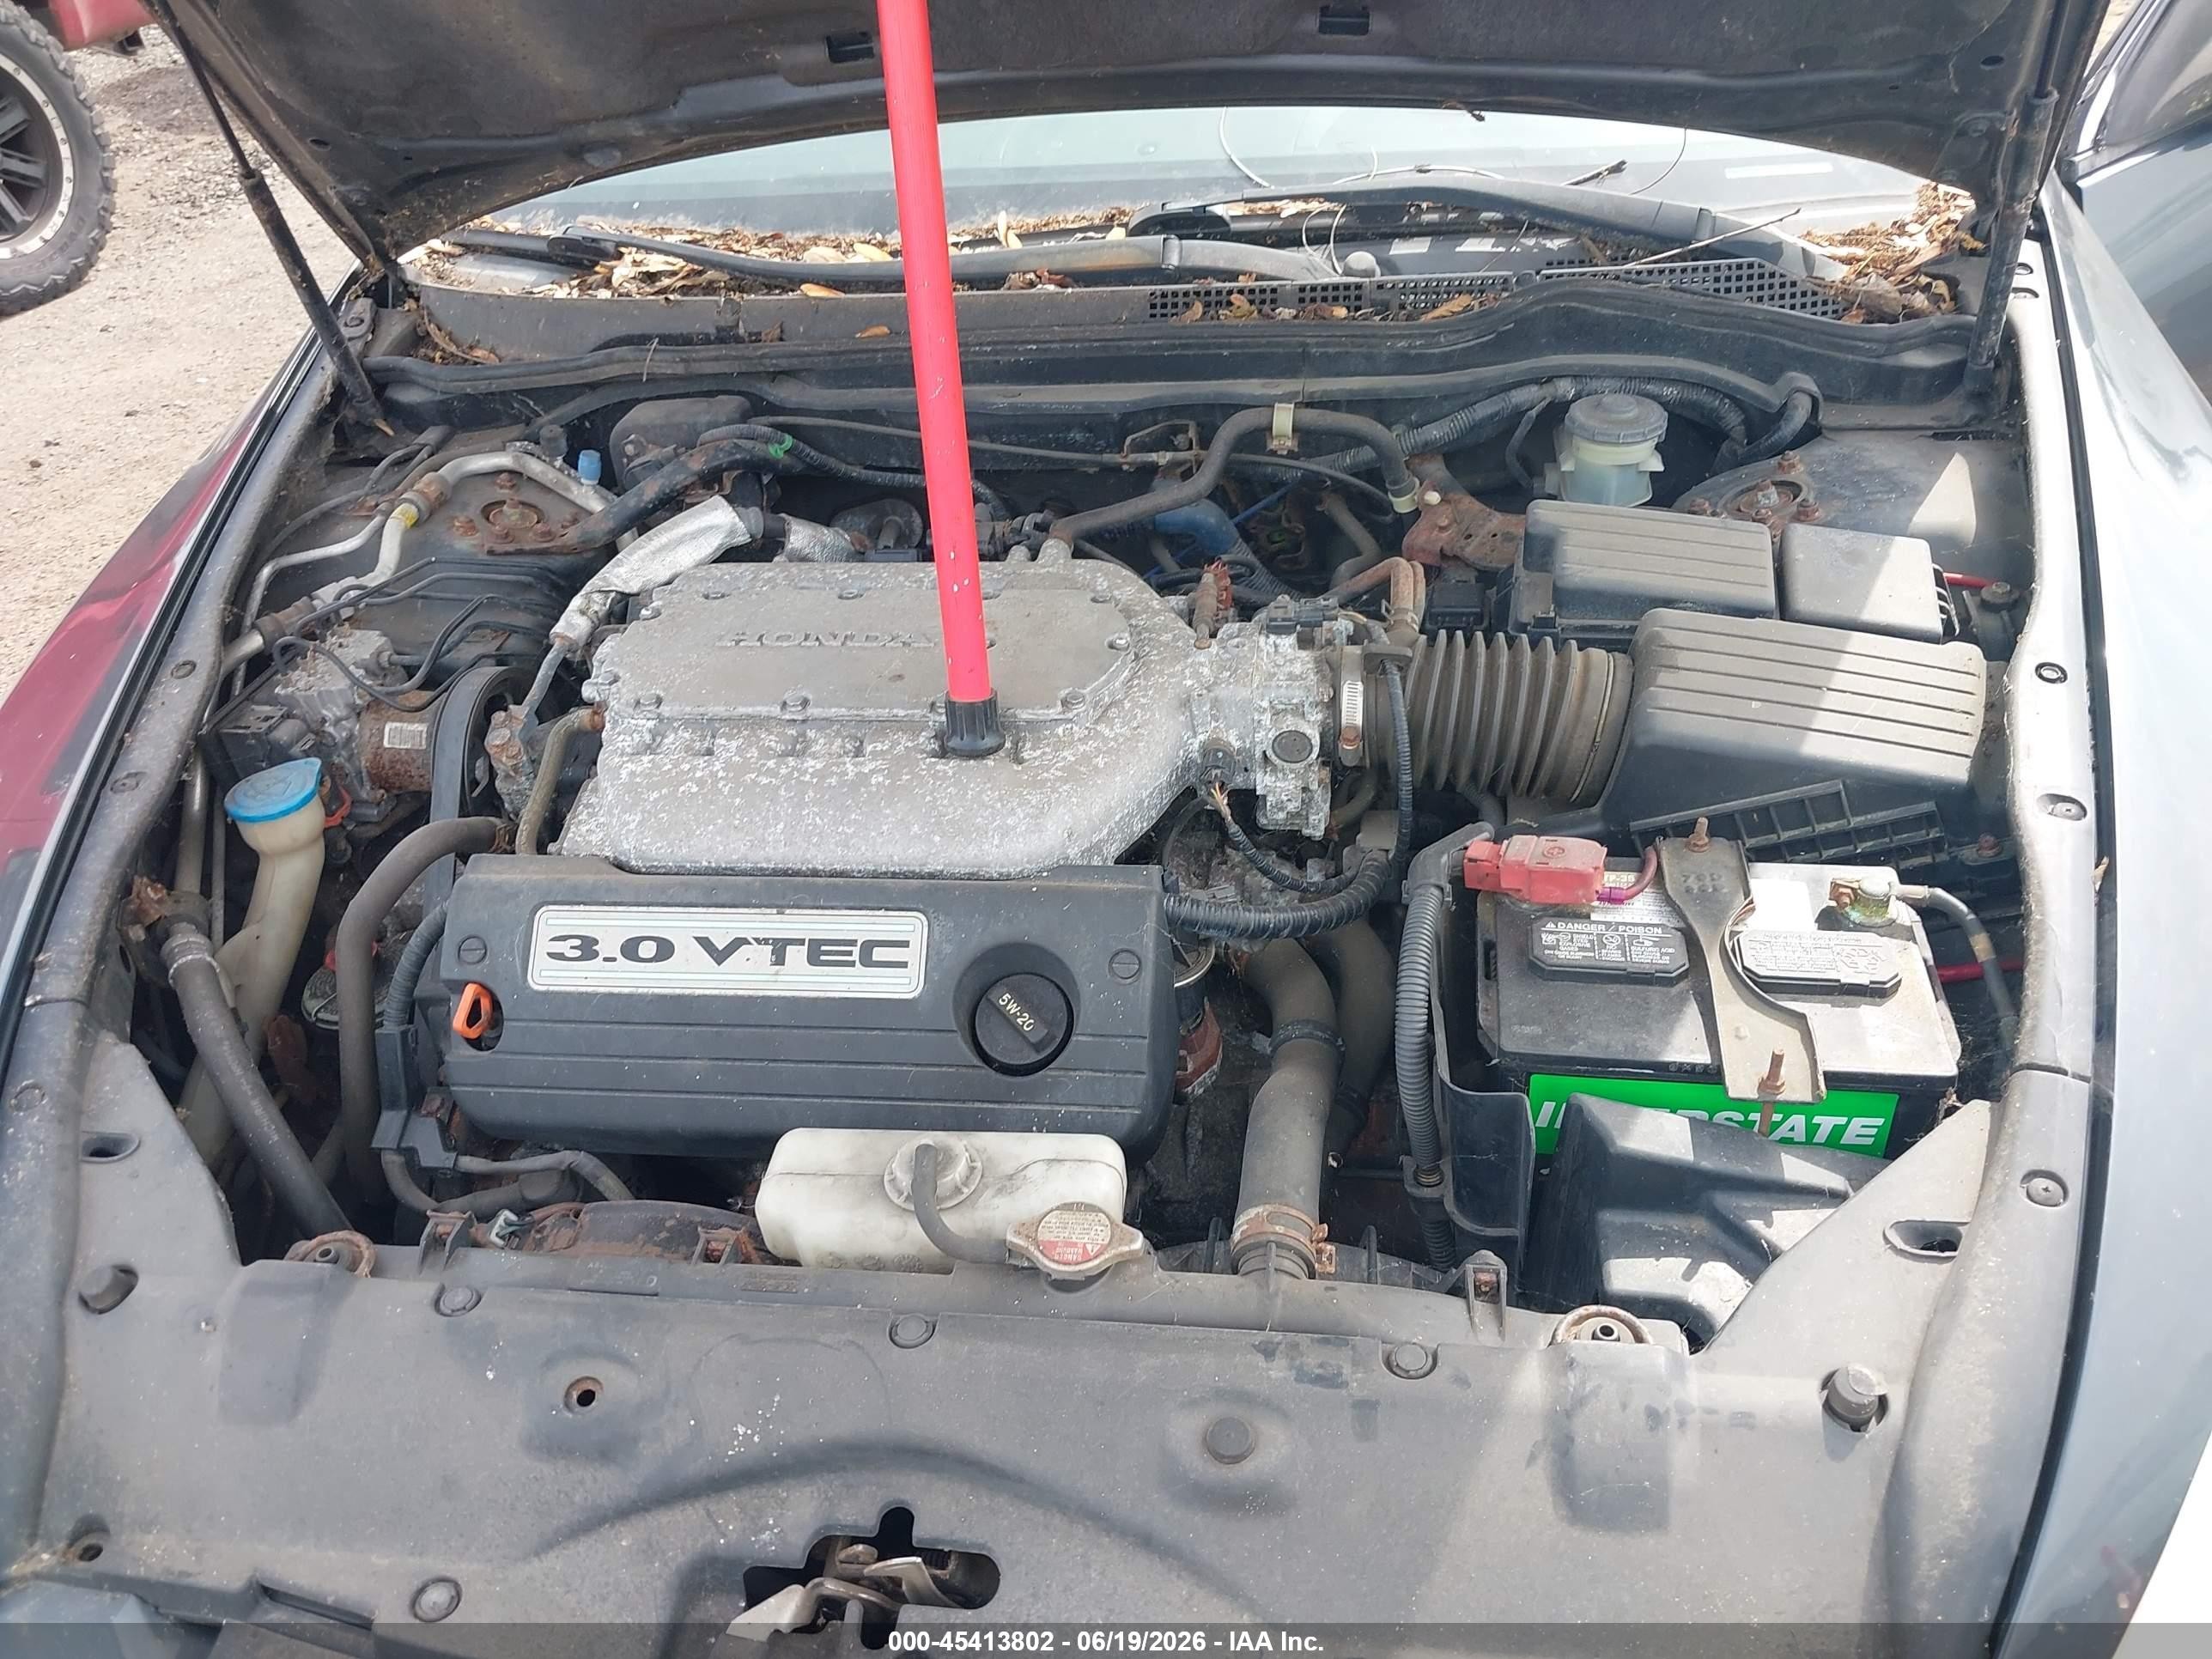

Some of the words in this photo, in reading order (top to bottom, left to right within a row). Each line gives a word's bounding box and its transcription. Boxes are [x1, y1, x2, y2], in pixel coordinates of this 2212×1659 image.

[716, 631, 936, 647] HONDA
[1557, 921, 1606, 933] DANGER
[1618, 925, 1662, 935] POISON
[545, 934, 675, 963] 3.0
[692, 936, 910, 969] VTEC
[999, 993, 1035, 1031] 5W-20
[1535, 1101, 1885, 1146] ISTATE
